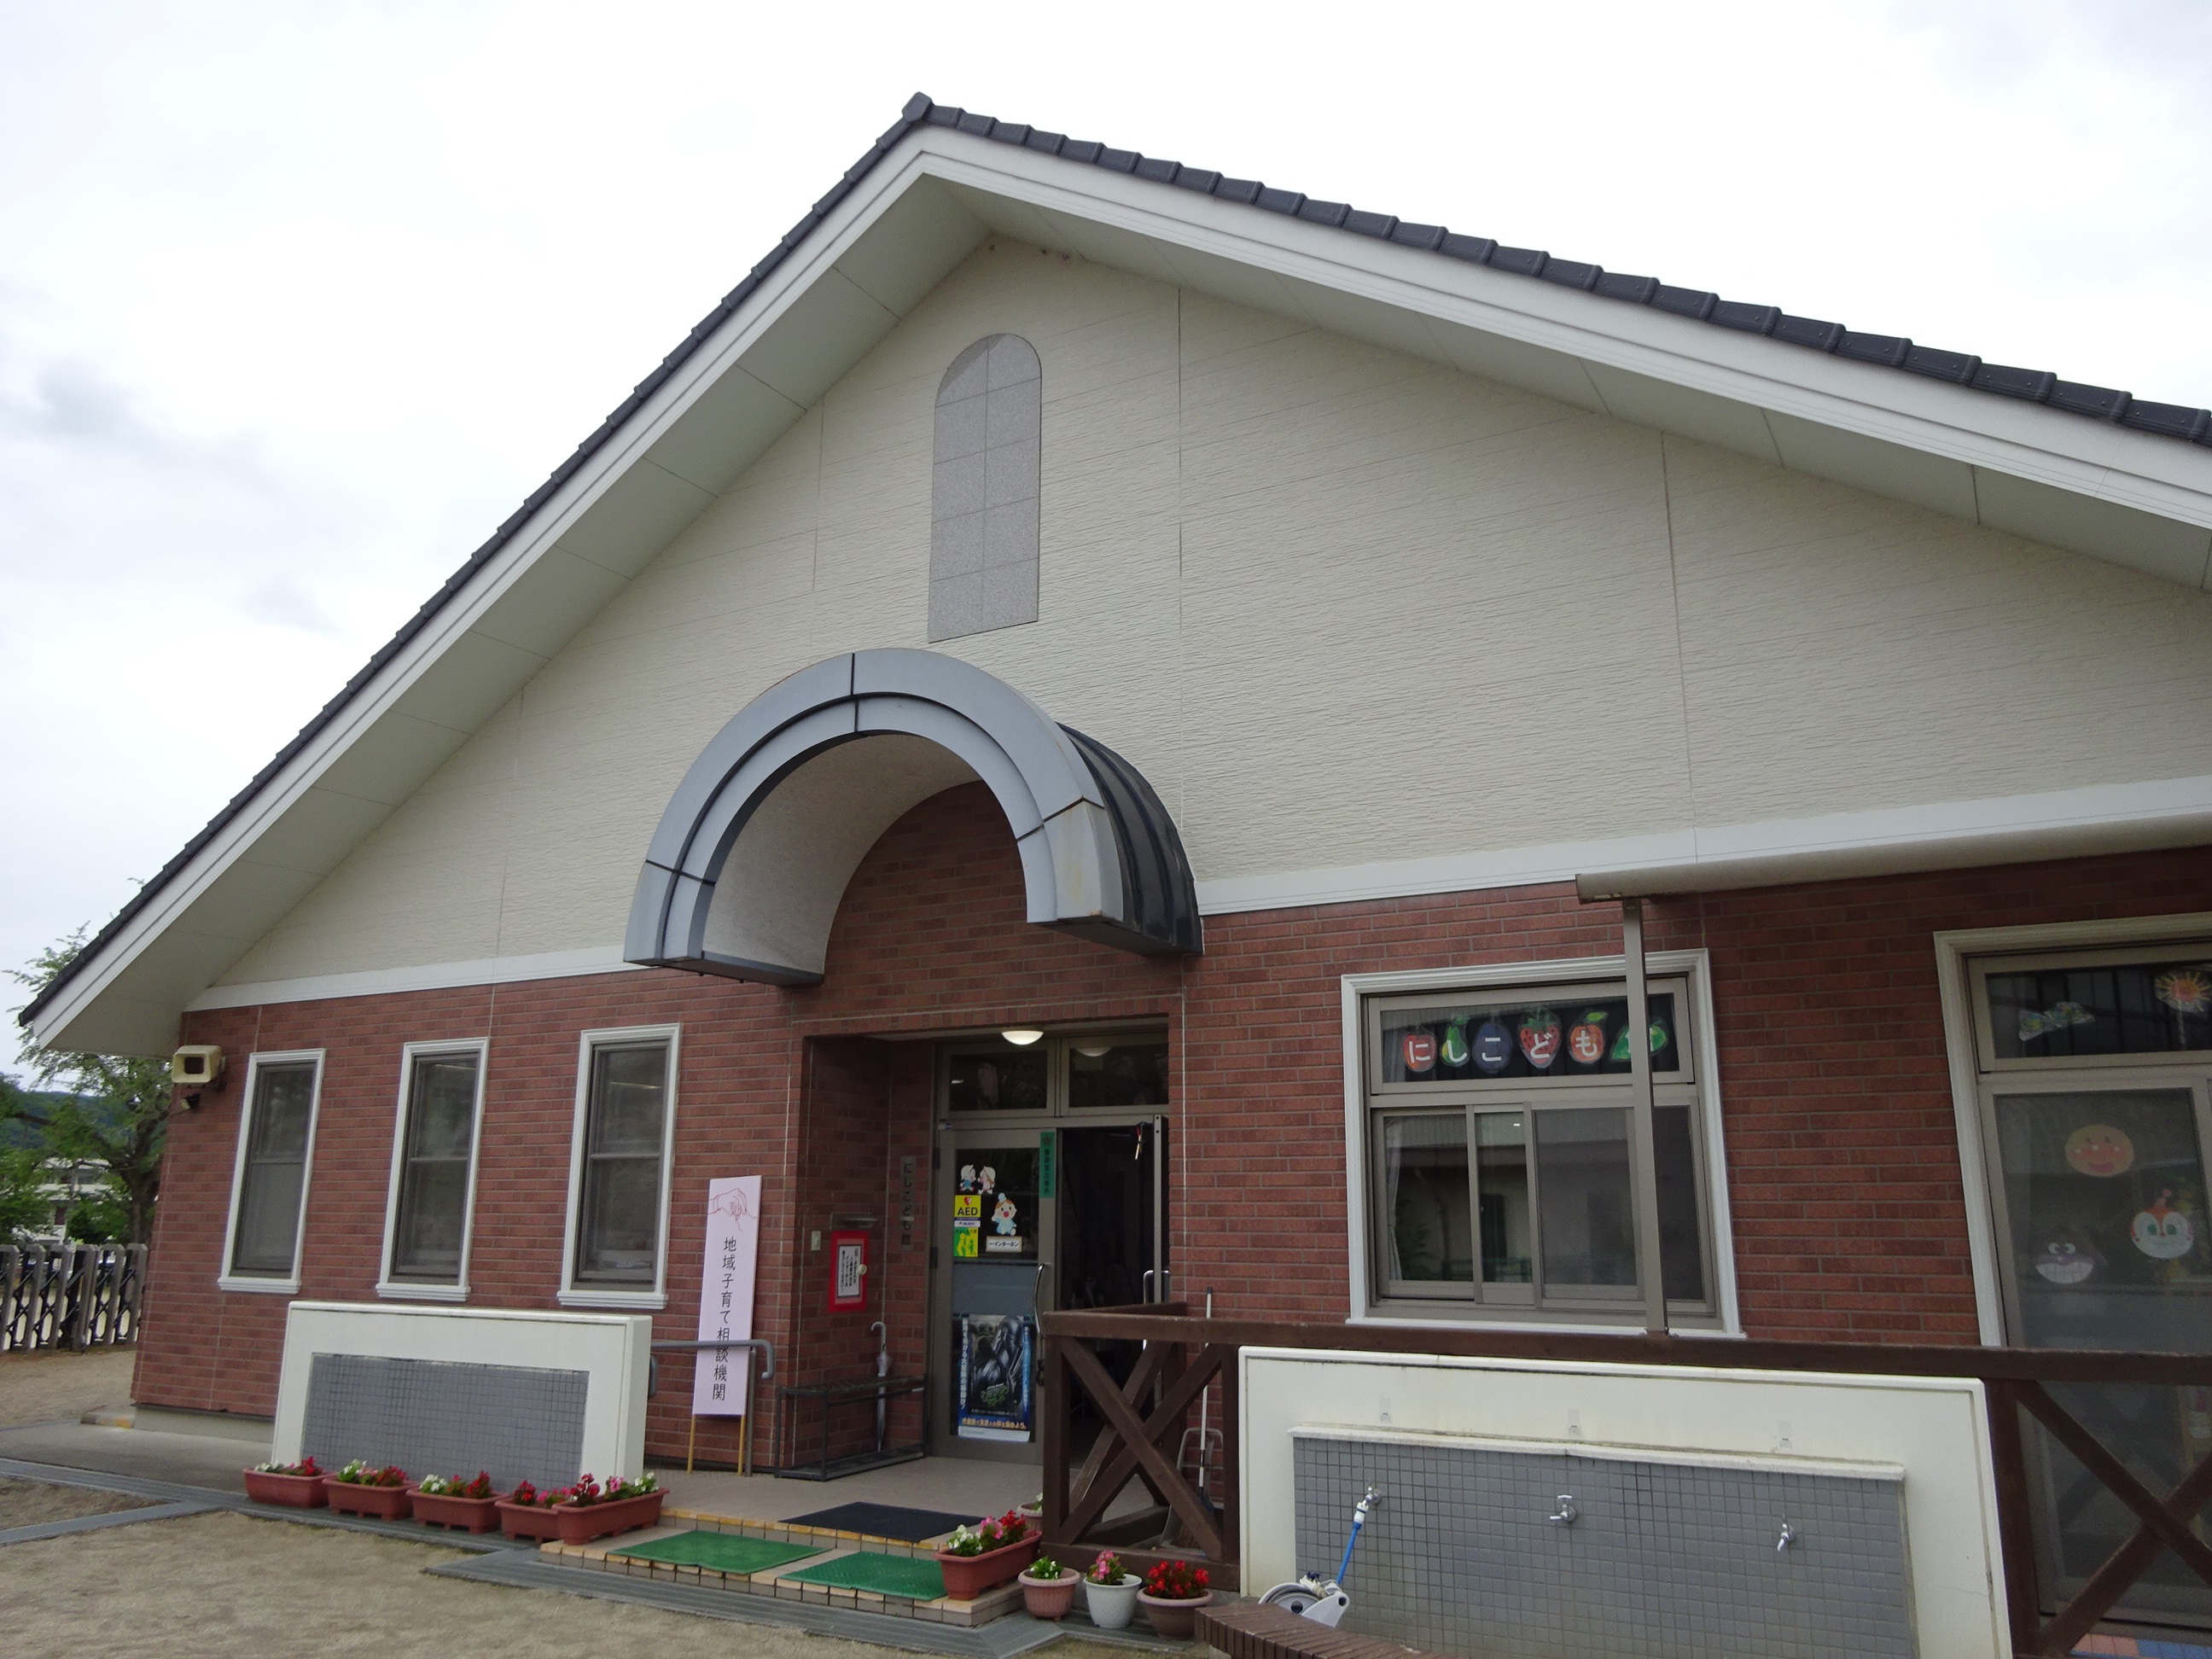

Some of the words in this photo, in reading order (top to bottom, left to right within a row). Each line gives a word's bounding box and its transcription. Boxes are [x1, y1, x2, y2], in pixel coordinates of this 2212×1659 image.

[1408, 1028, 1654, 1063] にしこども
[958, 1207, 978, 1216] AED
[712, 1236, 737, 1401] 地域子育て相談機関
